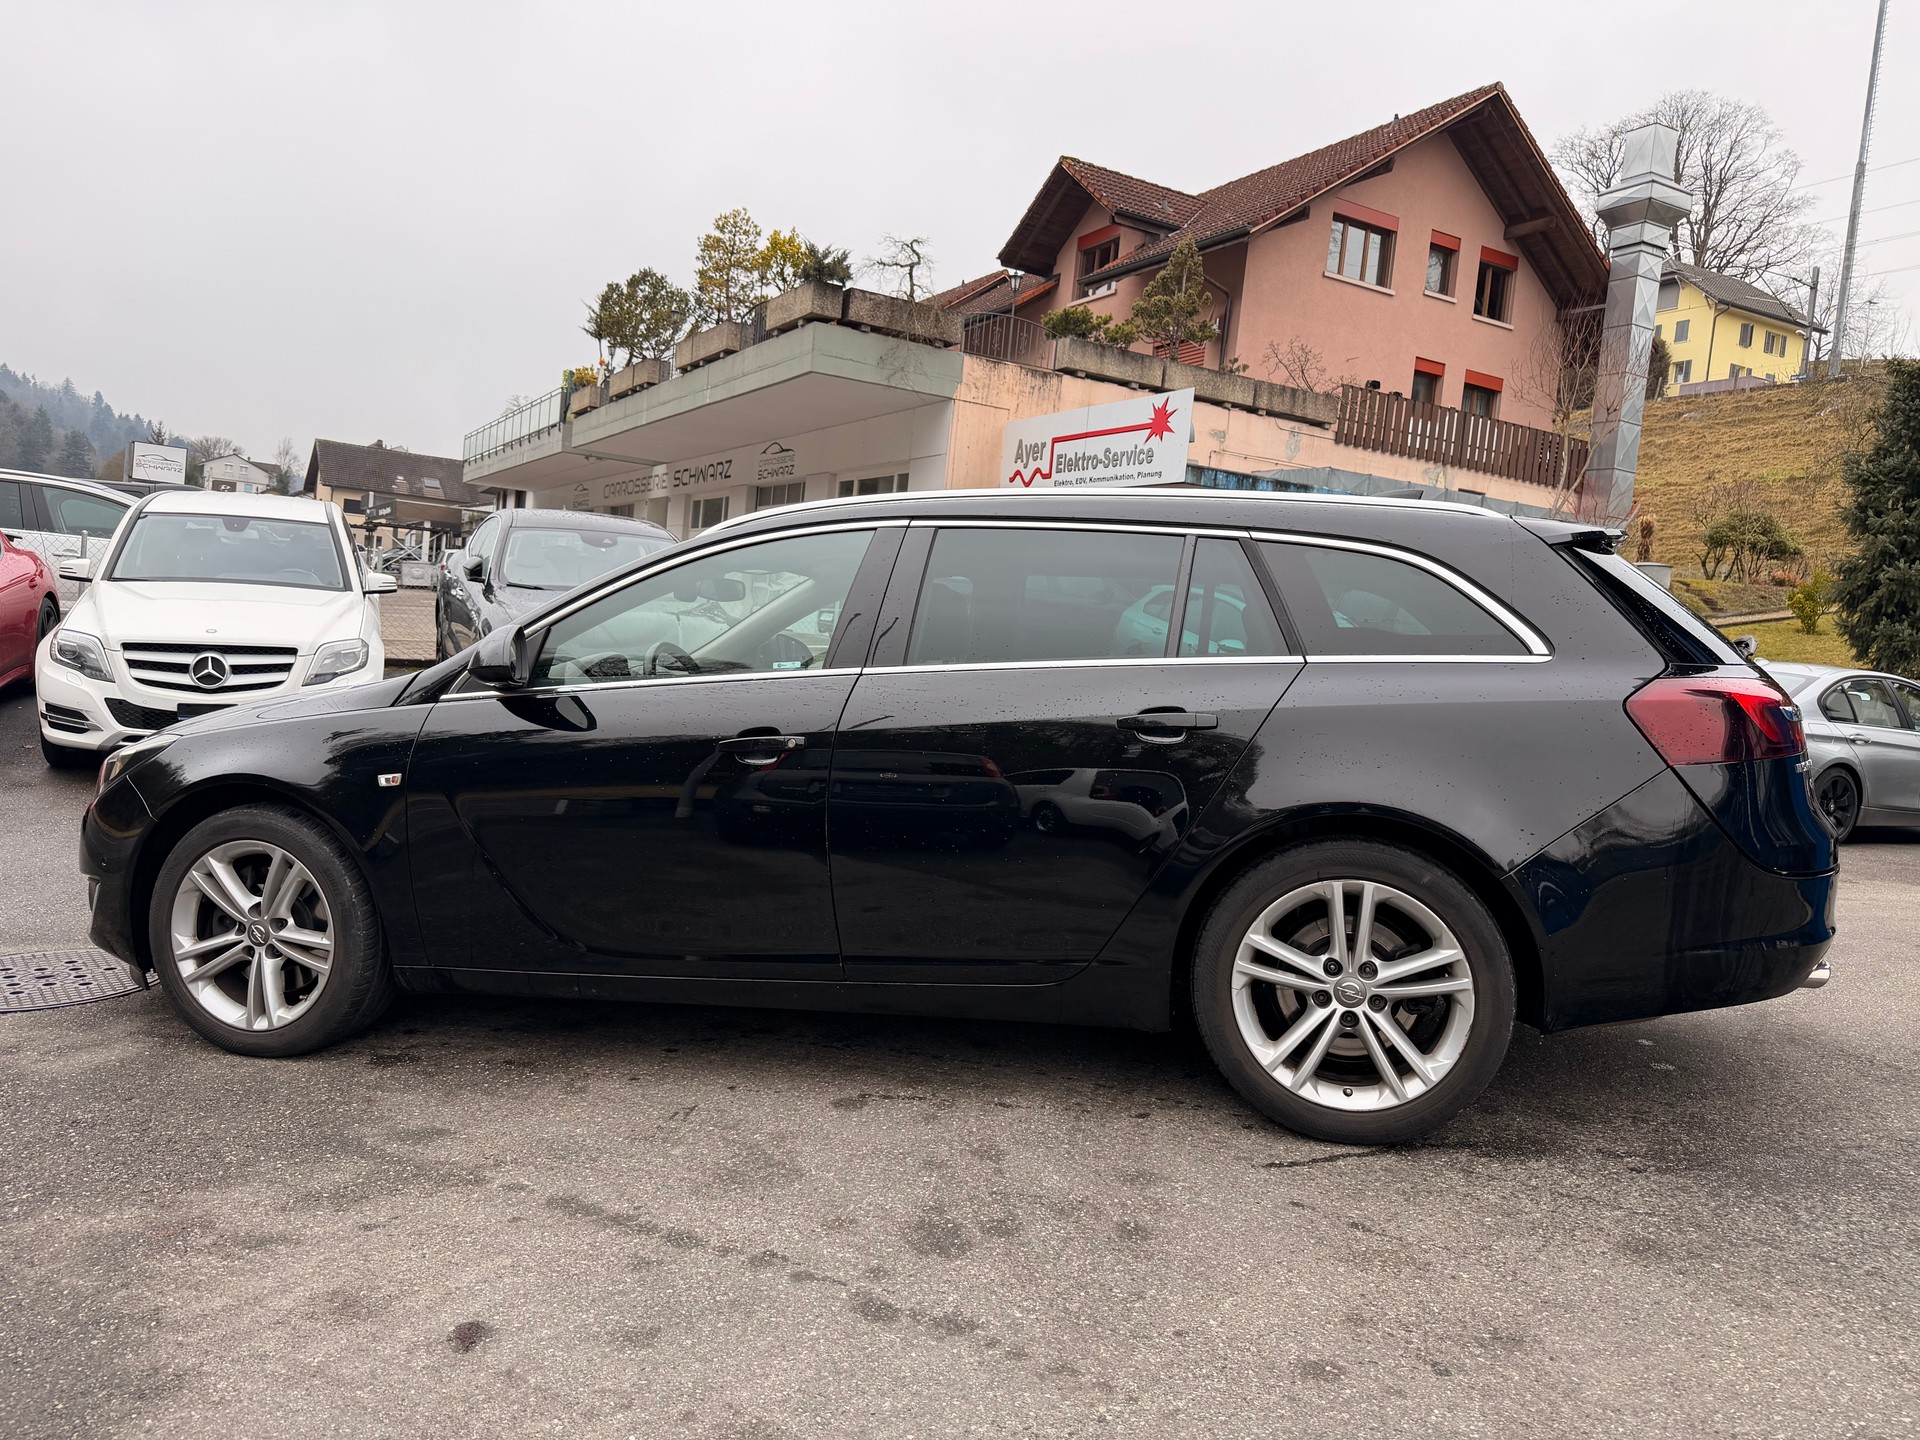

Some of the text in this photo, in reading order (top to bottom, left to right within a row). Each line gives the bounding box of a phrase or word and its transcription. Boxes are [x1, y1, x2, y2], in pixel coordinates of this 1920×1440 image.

[1014, 438, 1047, 469] Ayer
[1055, 444, 1154, 473] Elektro-Service
[135, 462, 183, 473] SCHWARZ
[604, 459, 733, 499] CARROSSERIE SCHWARZ
[757, 464, 795, 480] SCHWARZ
[1053, 470, 1163, 487] Elektro, EDV, Kommunikation, Planung
